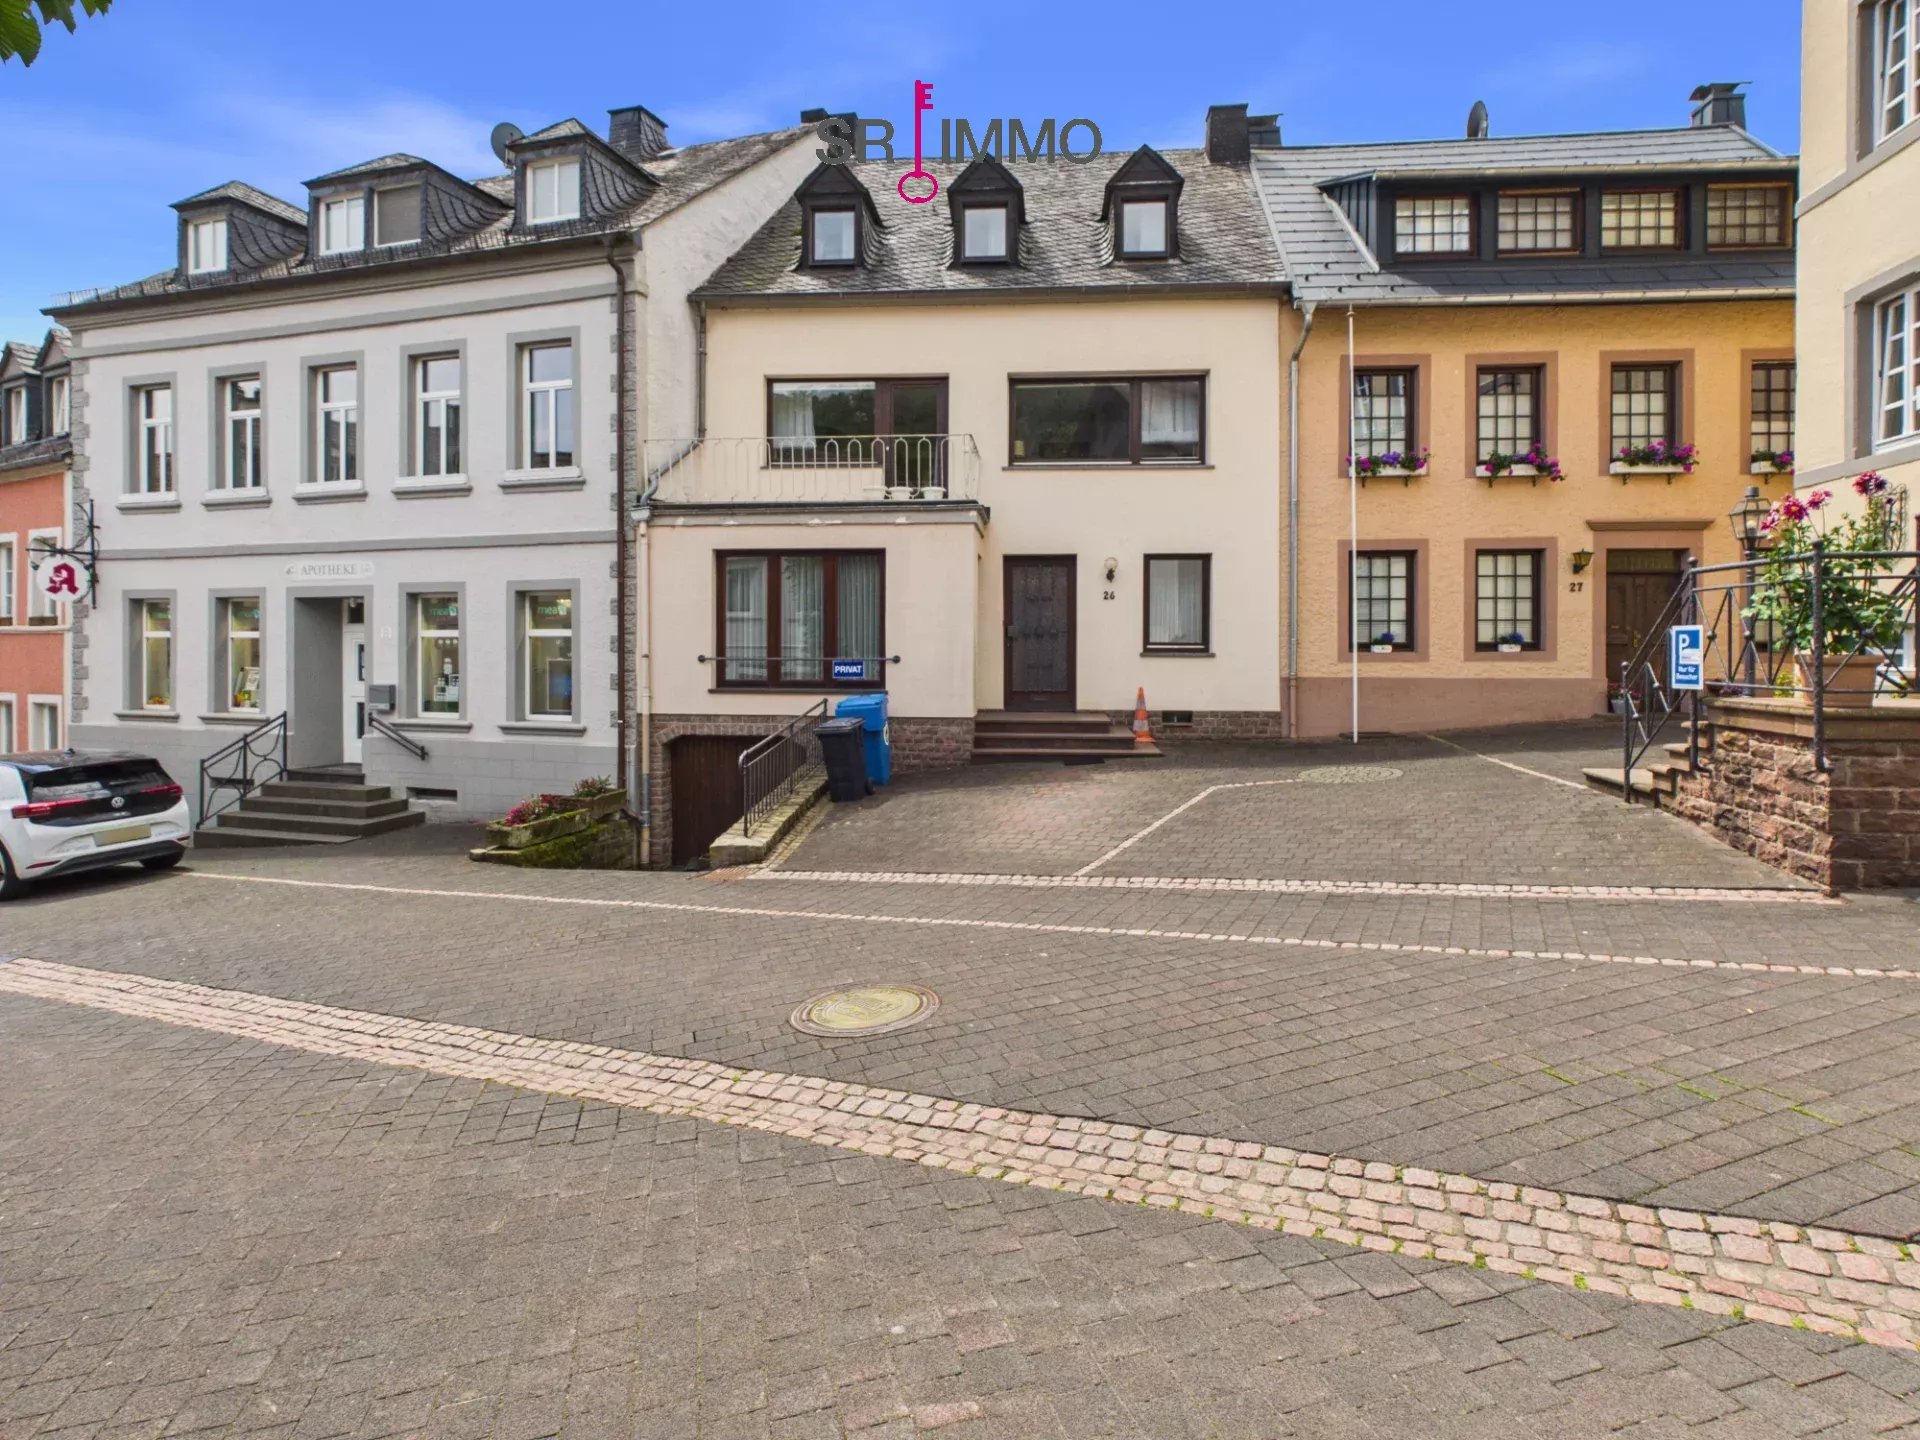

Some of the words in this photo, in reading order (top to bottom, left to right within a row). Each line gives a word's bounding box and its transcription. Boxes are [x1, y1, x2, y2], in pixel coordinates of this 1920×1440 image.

[302, 563, 355, 576] APOTHEKE
[1569, 582, 1583, 592] 27
[1103, 590, 1115, 600] 26
[834, 665, 862, 673] PRIVAT
[1678, 665, 1687, 673] Nur
